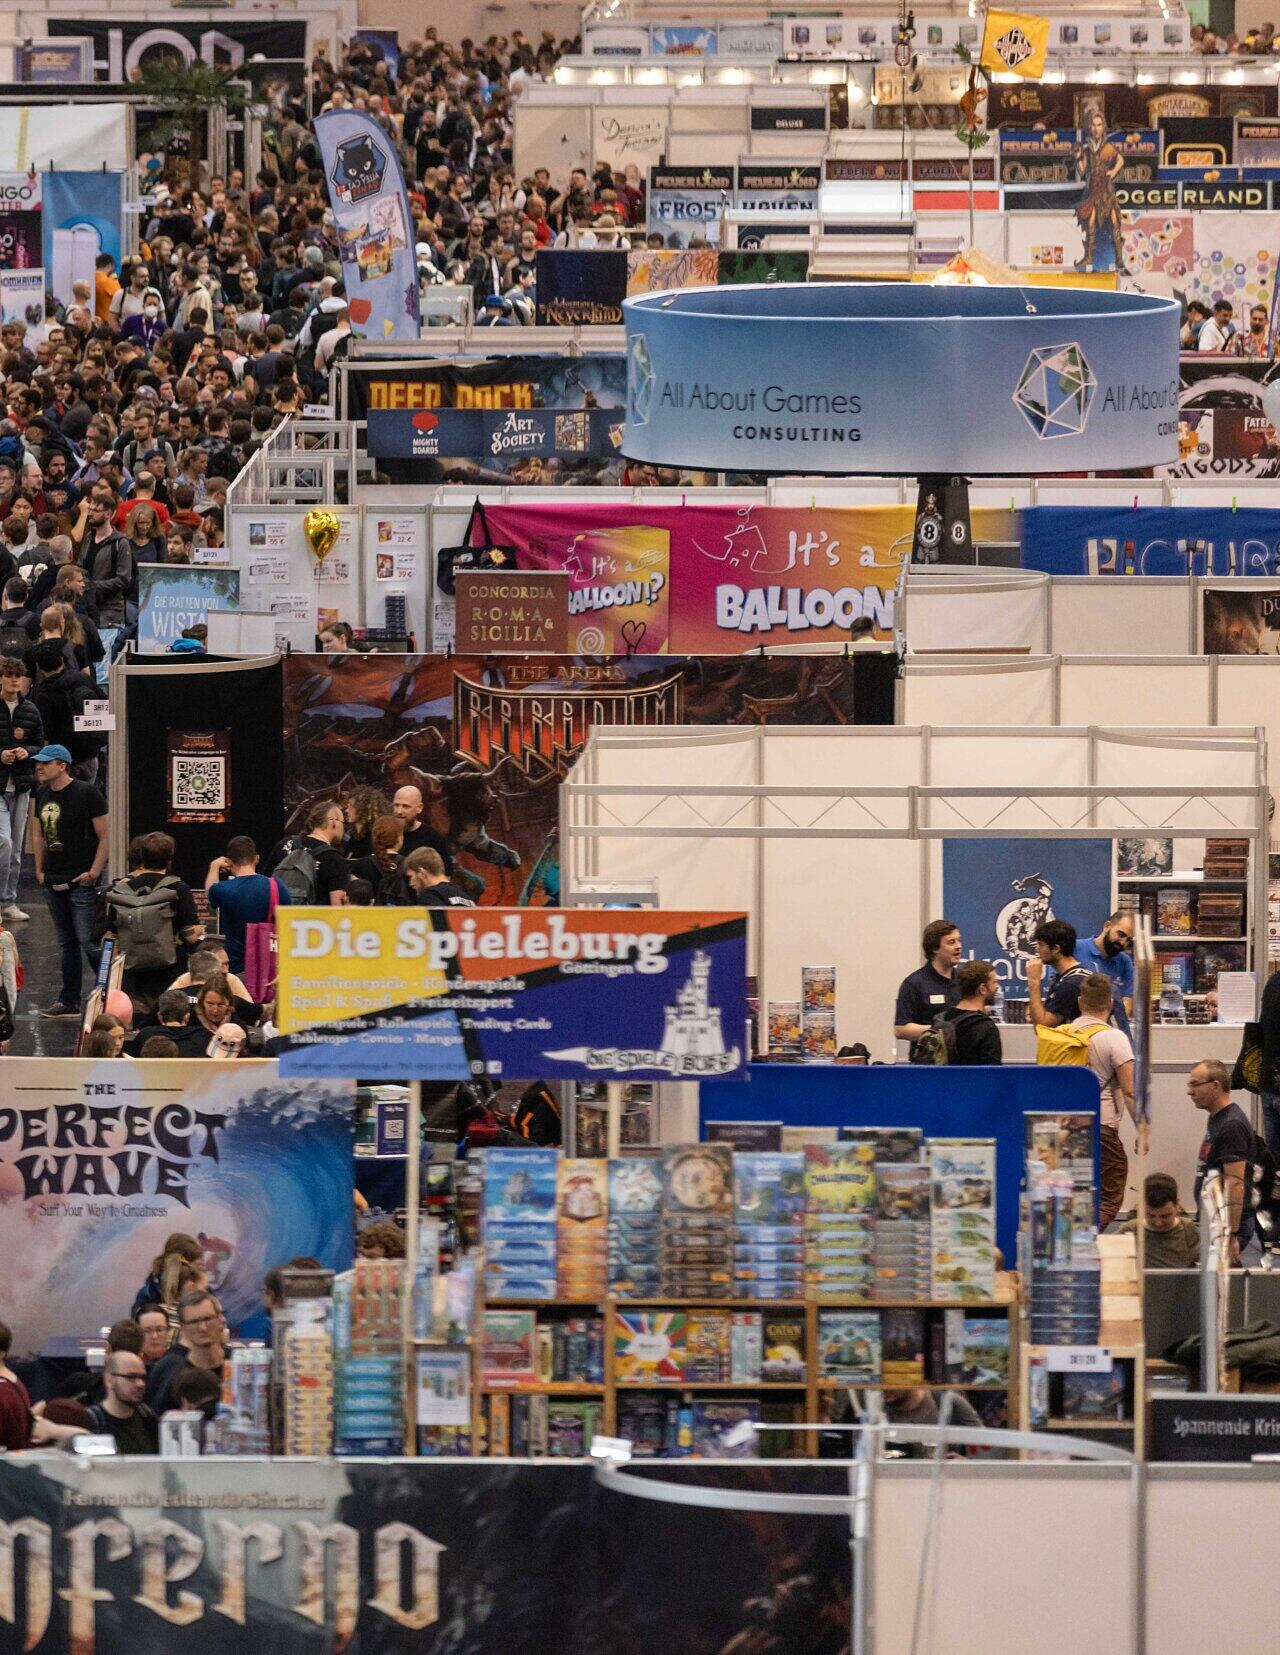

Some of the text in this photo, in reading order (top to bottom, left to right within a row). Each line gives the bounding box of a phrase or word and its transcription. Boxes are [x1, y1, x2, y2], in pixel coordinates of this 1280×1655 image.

[659, 382, 862, 414] All About Games
[1103, 386, 1126, 412] All
[1129, 385, 1168, 411] About
[503, 412, 534, 431] ART
[413, 438, 439, 446] MIGHTY
[732, 425, 862, 442] CONSULTING
[413, 446, 439, 454] BOARDS
[491, 432, 546, 455] SOCIETY
[923, 524, 935, 540] 8
[955, 526, 962, 537] 8
[784, 530, 841, 572] It's
[1087, 538, 1280, 576] PICTUR
[469, 586, 556, 599] CONCORDIA
[154, 596, 167, 608] DIE
[168, 596, 200, 609] RATTEN
[716, 584, 896, 633] BALLOON
[544, 618, 554, 629] &
[470, 625, 546, 642] SICILIA
[508, 665, 626, 681] THE ARENA
[289, 914, 669, 974] Die Spieleburg
[84, 1084, 116, 1095] THE
[15, 1151, 191, 1209] WAVE
[40, 1204, 168, 1218] Surf Your Way to Greatness
[1173, 1416, 1250, 1438] Spannende
